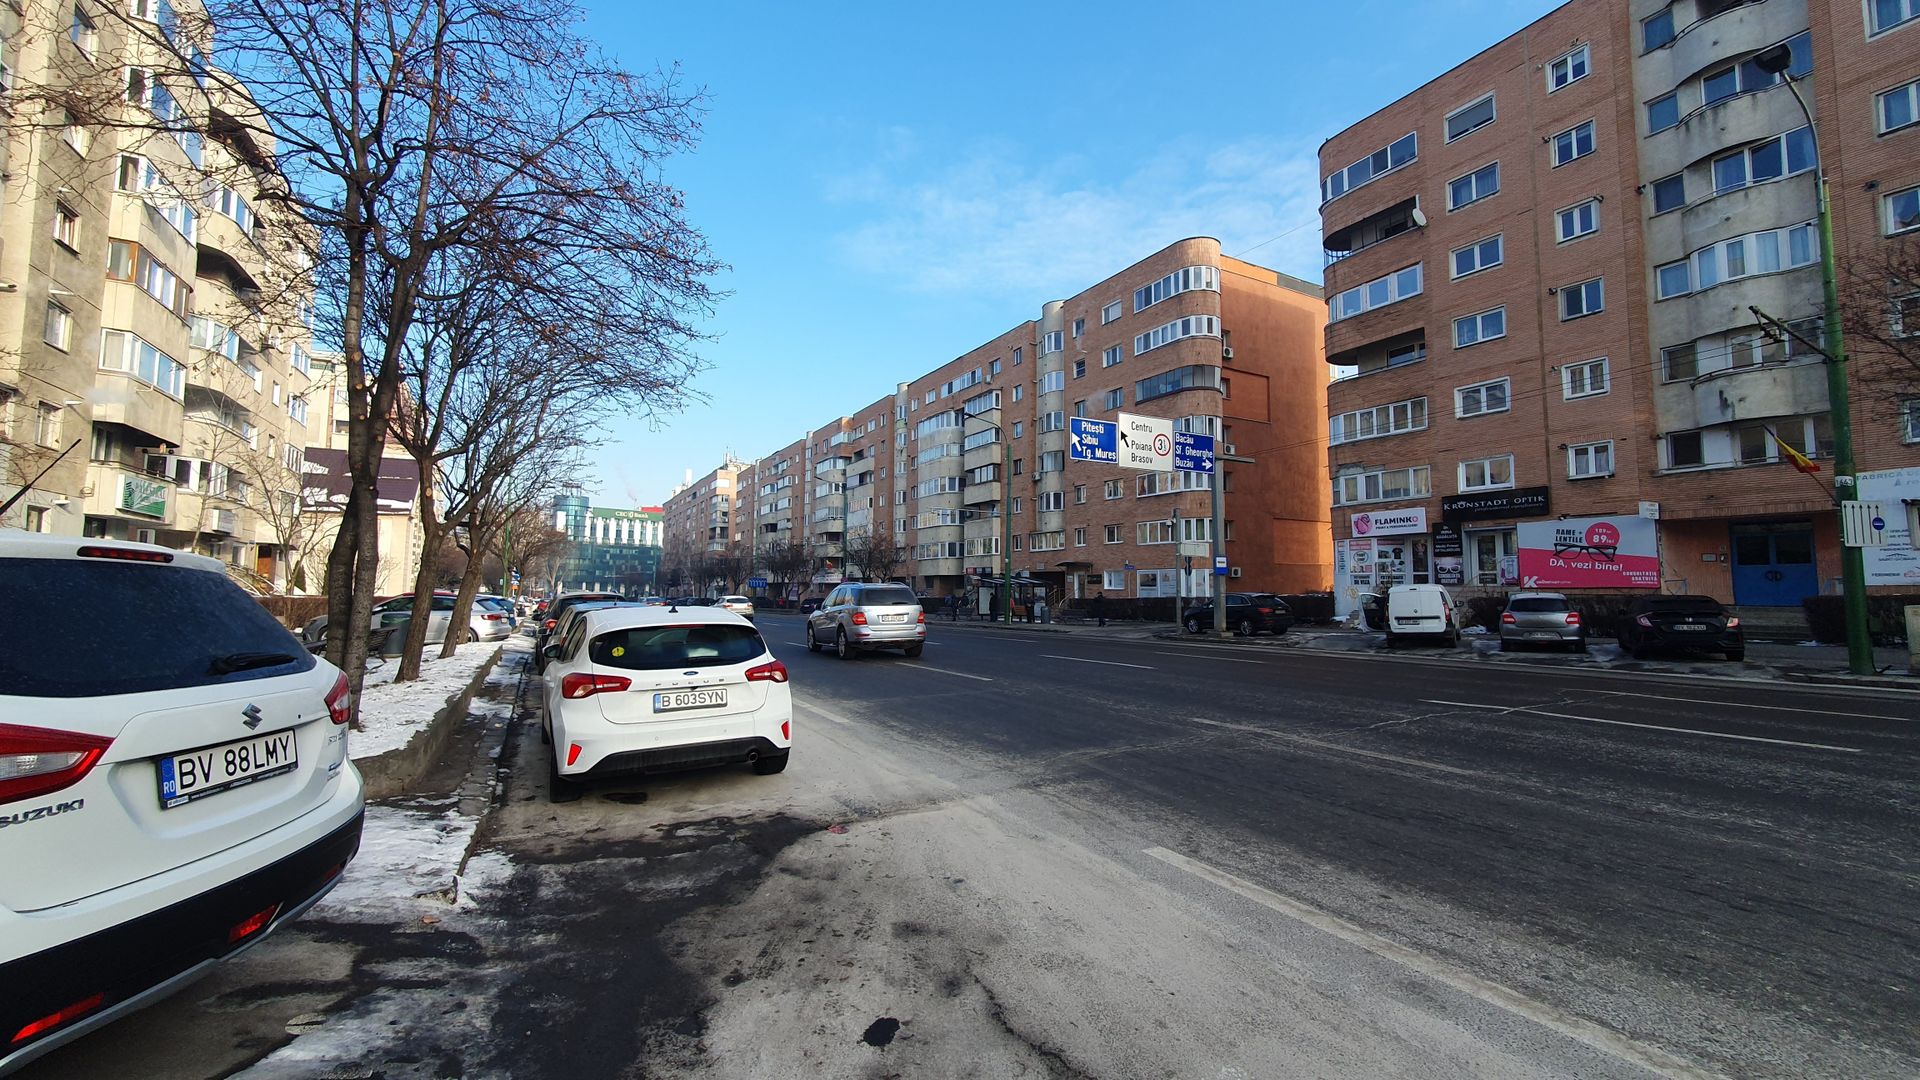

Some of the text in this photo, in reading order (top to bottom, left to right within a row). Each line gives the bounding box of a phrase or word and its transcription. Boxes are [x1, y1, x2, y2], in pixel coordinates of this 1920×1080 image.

[1131, 421, 1153, 433] Centru
[1082, 434, 1099, 445] Sibiu
[1175, 432, 1194, 445] Bacău
[1082, 446, 1093, 459] Tg.
[1131, 440, 1153, 452] Poiana
[1175, 444, 1184, 455] Sf.
[1185, 445, 1214, 459] Gheorghe
[1175, 457, 1194, 468] Buzău
[1443, 498, 1509, 511] KRONSTADT
[1513, 495, 1545, 504] OPTIK
[1374, 515, 1419, 526] FLAMINKO
[1555, 528, 1576, 536] RAME
[1593, 534, 1607, 543] 89
[1555, 536, 1583, 544] LENTILE
[1549, 558, 1567, 568] DA,
[1595, 562, 1623, 571] bine!
[662, 691, 724, 707] B 603SYN
[178, 735, 290, 790] BV 88LMY
[163, 780, 176, 794] RO
[0, 798, 84, 829] SUZUKI
